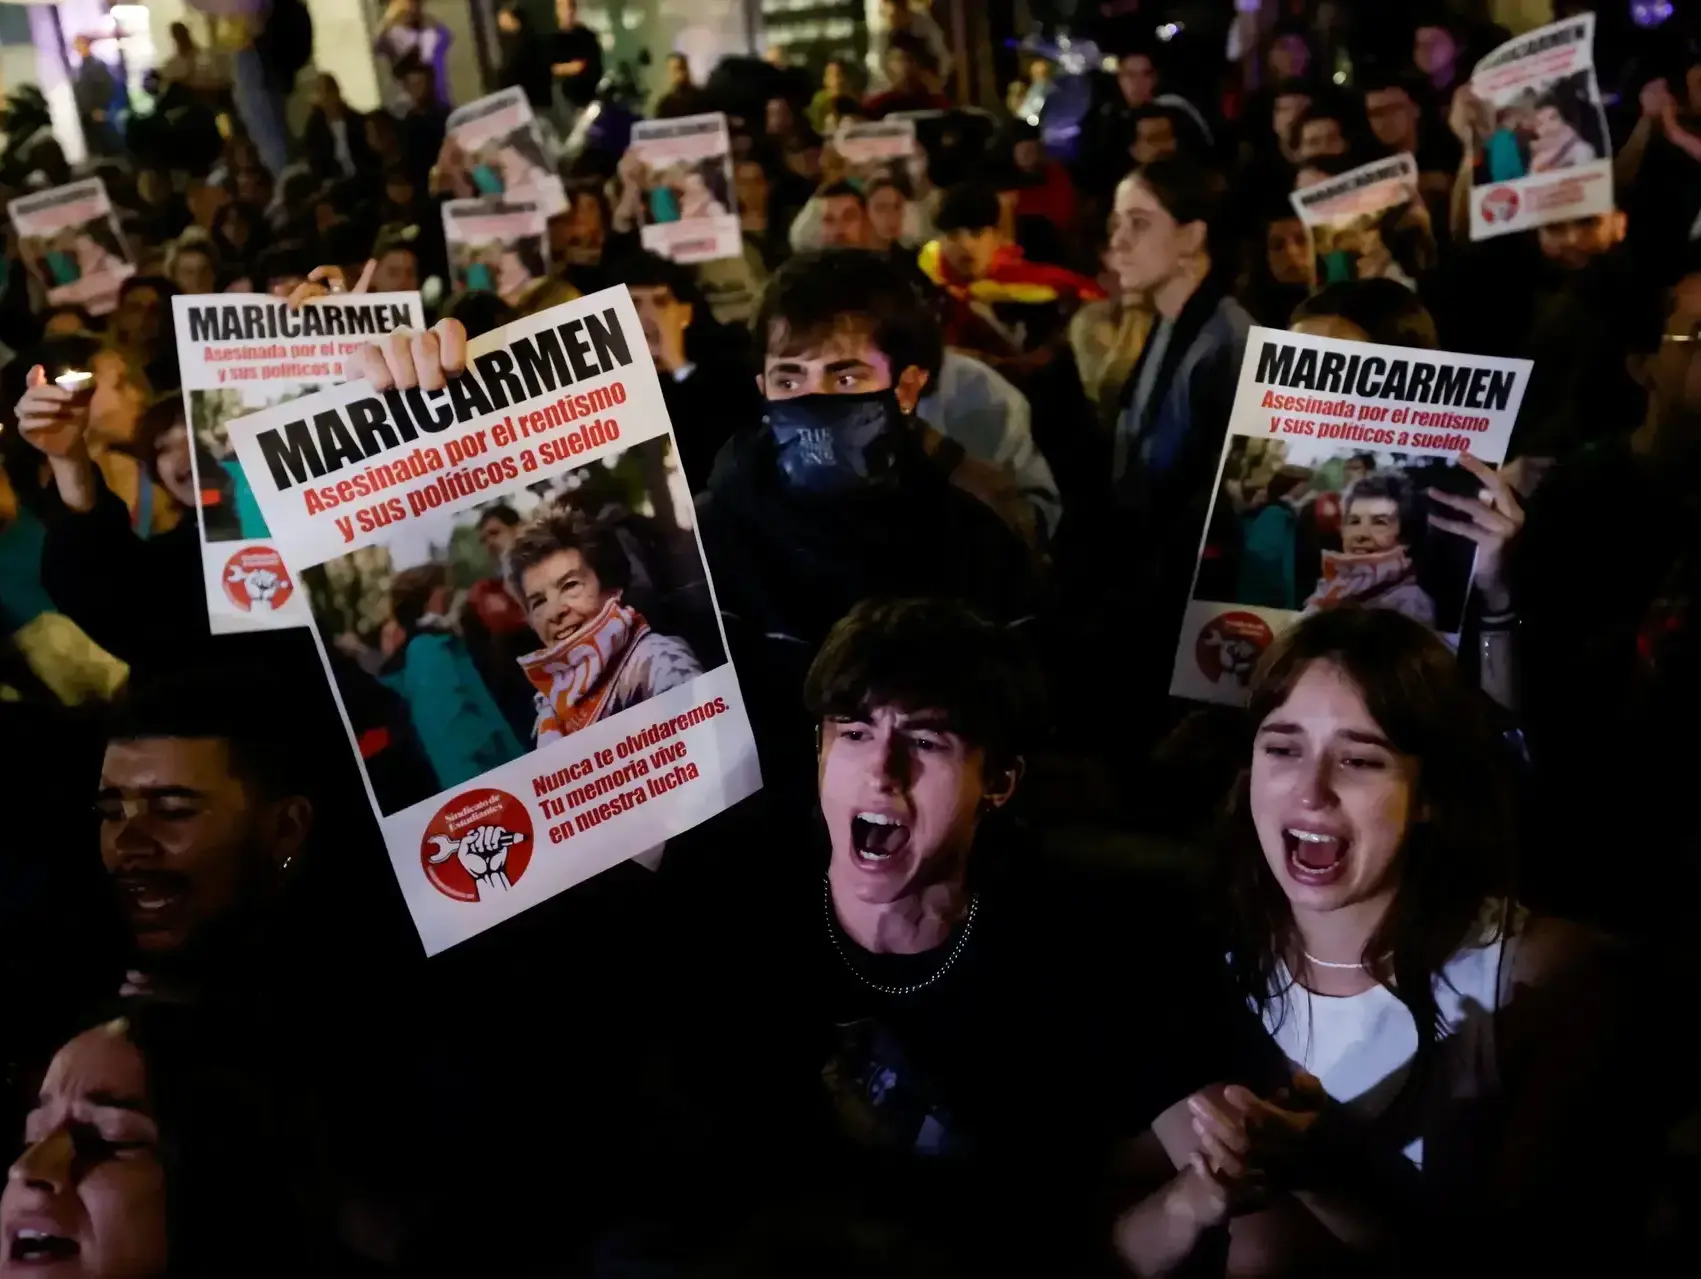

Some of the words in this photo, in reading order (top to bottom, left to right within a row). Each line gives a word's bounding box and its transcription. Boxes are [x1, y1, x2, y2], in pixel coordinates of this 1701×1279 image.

[188, 303, 412, 341] MARICARMEN
[204, 345, 288, 362] Asesinada
[290, 343, 317, 359] por
[320, 340, 335, 356] el
[217, 368, 227, 383] y
[230, 366, 257, 380] sus
[256, 307, 633, 491] MARICARMEN
[1255, 342, 1516, 411] MARICARMEN
[1261, 389, 1355, 418] Asesinada
[1357, 405, 1389, 423] por
[1391, 406, 1409, 425] el
[1411, 410, 1490, 432] rentismo
[303, 448, 444, 516] Asesinada
[444, 429, 488, 467] por
[491, 416, 518, 447] el
[518, 382, 627, 438] rentismo
[1269, 416, 1279, 433] y
[1282, 417, 1314, 435] sus
[1317, 420, 1394, 445] políticos
[1397, 432, 1409, 446] a
[1411, 432, 1470, 452] sueldo
[334, 516, 355, 543] y
[356, 497, 407, 533] sus
[406, 455, 519, 517] políticos
[520, 449, 538, 474] a
[538, 419, 621, 465] sueldo
[532, 758, 594, 797] Nunca
[594, 748, 614, 769] te
[616, 697, 730, 759] olvidaremos.
[538, 796, 566, 821] Tu
[566, 758, 649, 810] memoria
[650, 741, 687, 770] vive
[549, 820, 575, 844] en
[574, 786, 647, 833] nuestra
[646, 762, 699, 799] lucha
